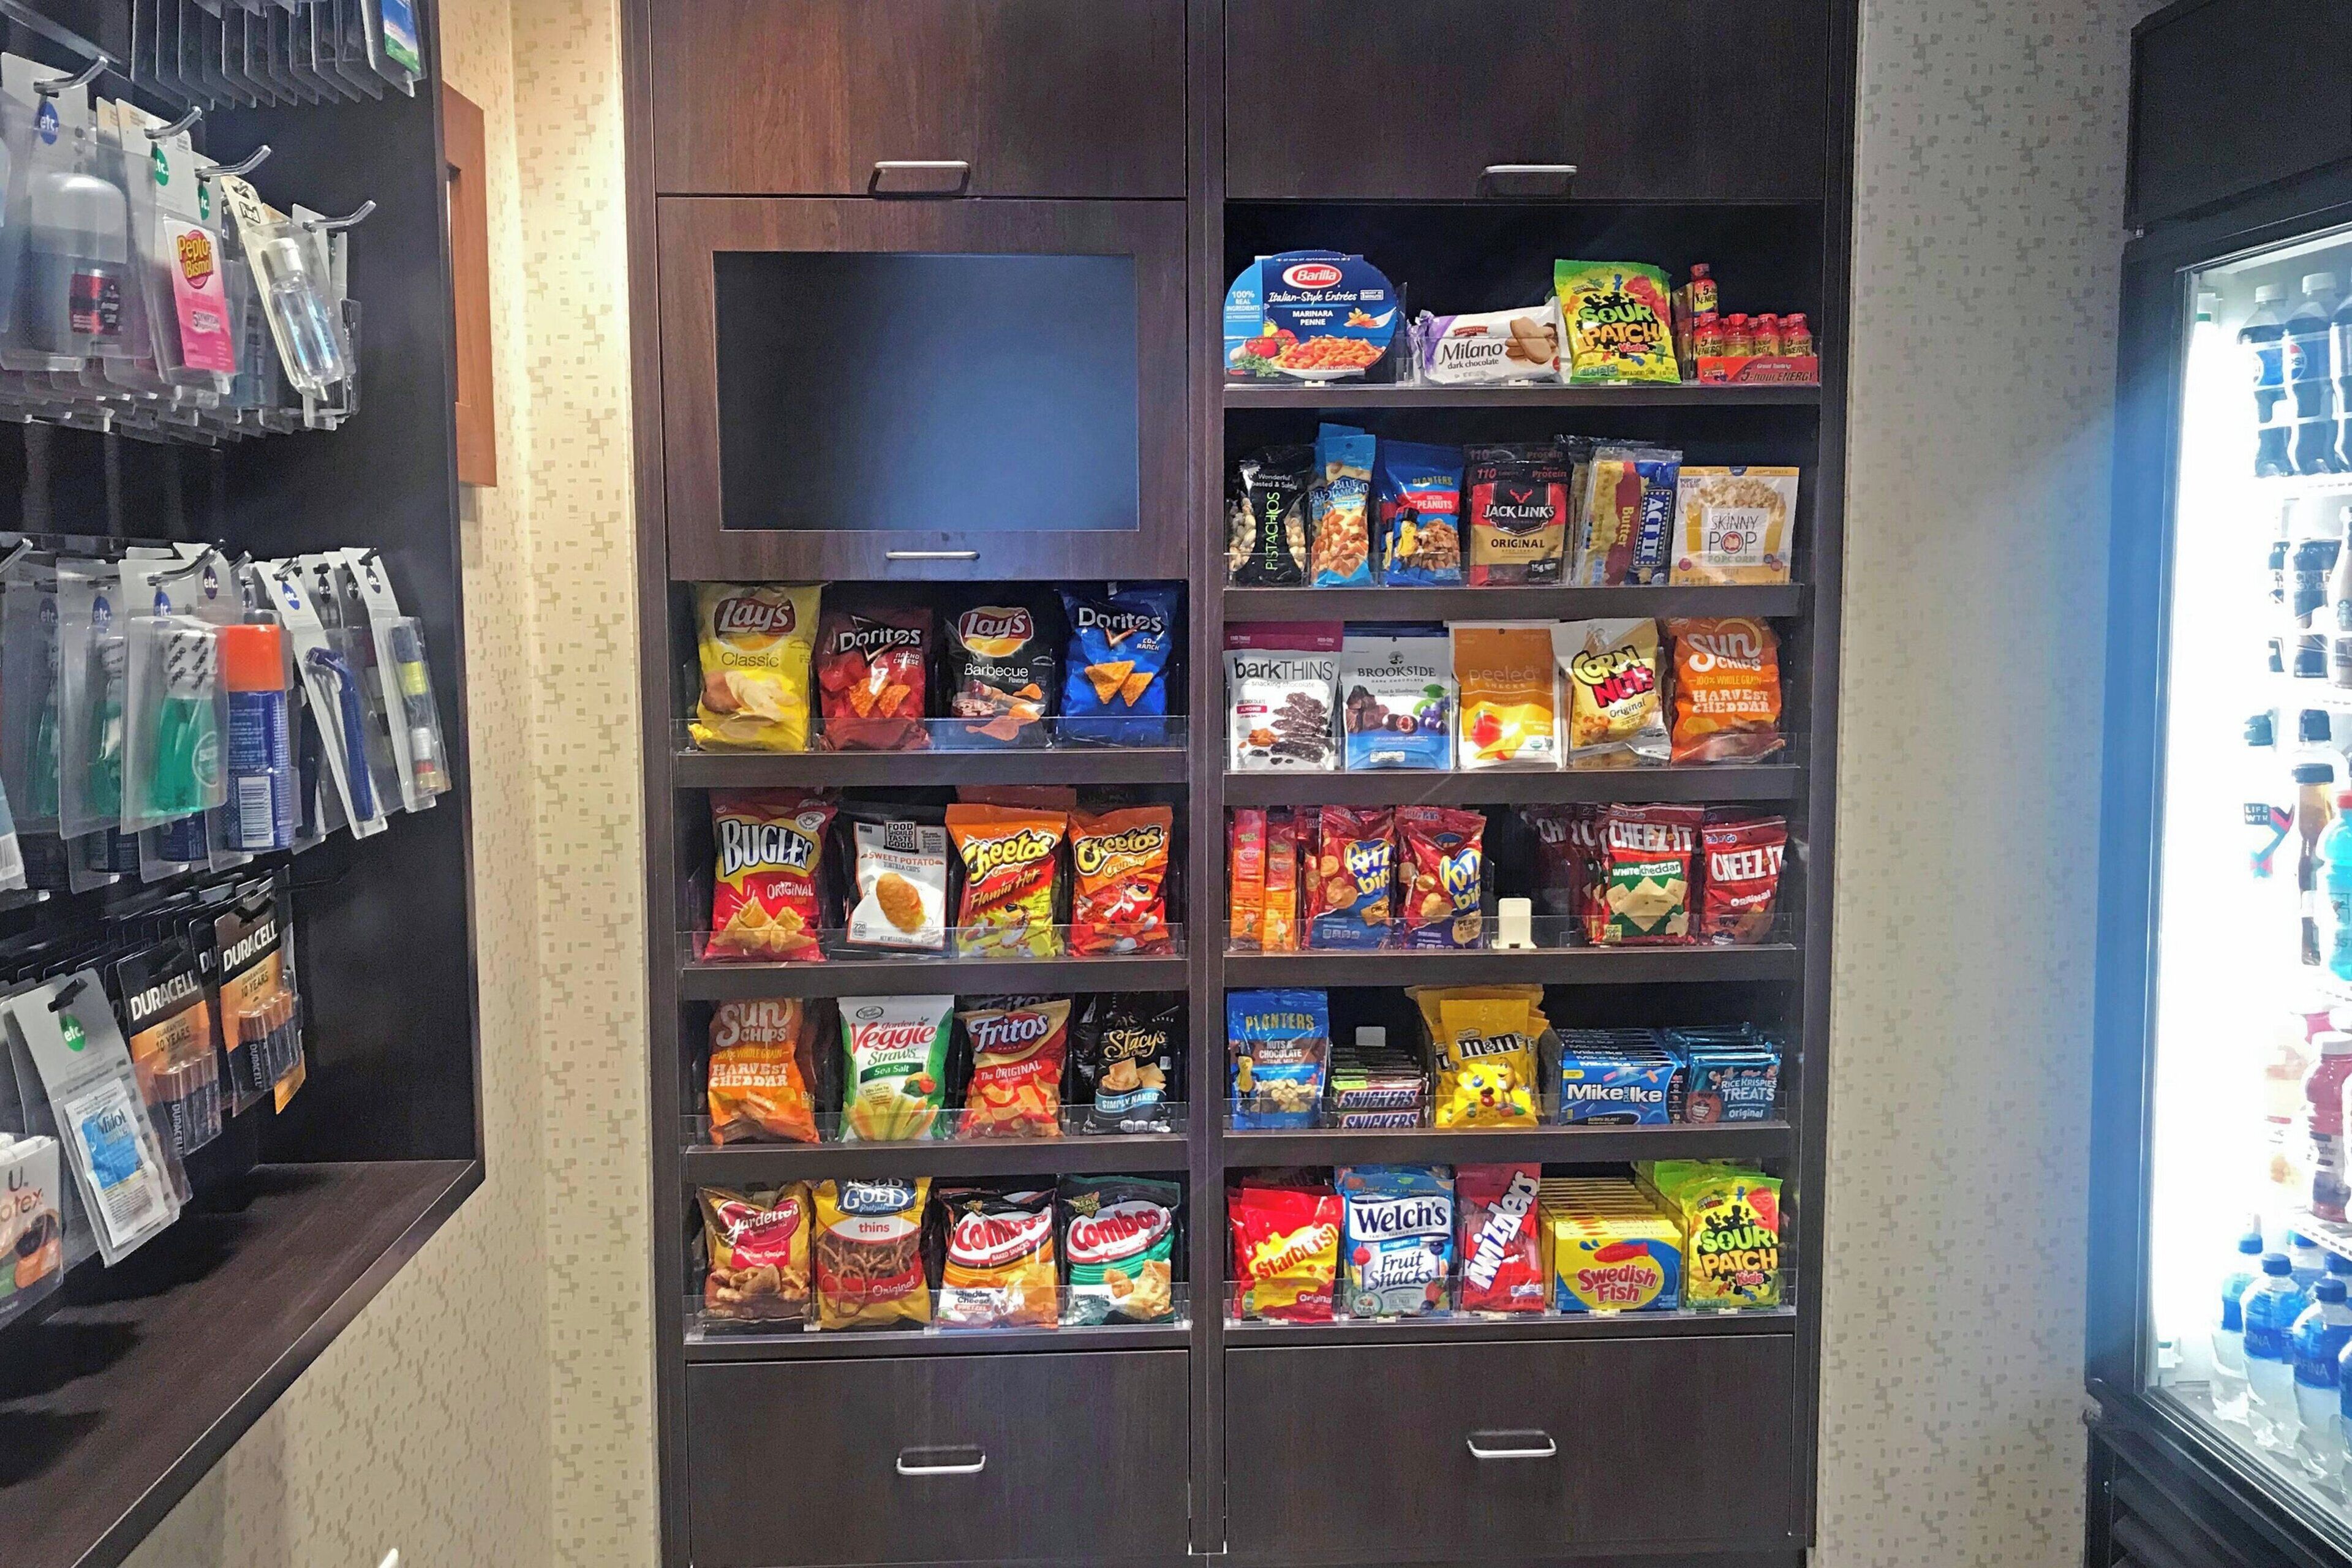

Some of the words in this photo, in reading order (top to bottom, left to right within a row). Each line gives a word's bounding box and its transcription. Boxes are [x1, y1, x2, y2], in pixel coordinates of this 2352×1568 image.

[177, 235, 211, 260] Pepto-
[185, 252, 214, 278] Bismol
[1297, 270, 1336, 281] Barilla
[1268, 290, 1323, 306] Italian-Style
[1325, 290, 1357, 301] Entrées
[1579, 303, 1653, 323] SOUR
[1579, 322, 1662, 347] PATCH
[1439, 339, 1503, 365] Milano
[1465, 358, 1499, 368] chocolate
[1777, 371, 1814, 382] ENERGY
[1417, 500, 1453, 510] PEANUTS
[1482, 505, 1517, 519] JACK
[1517, 505, 1555, 519] LINK'S
[1265, 492, 1281, 571] PISTACHIOS
[1618, 506, 1635, 546] Butter
[1711, 513, 1759, 530] SKINNY
[1491, 538, 1545, 548] ORIGINAL
[1708, 531, 1757, 554] POP
[718, 598, 791, 635] Lay's
[965, 612, 1027, 640] Lay's
[1079, 606, 1164, 632] Doritos
[839, 627, 921, 652] Doritos
[1687, 619, 1763, 672] Sun
[721, 650, 779, 668] Classic
[1234, 657, 1333, 680] barkTHINS
[1716, 656, 1762, 671] CHIPS
[964, 663, 1028, 677] Barbecue
[1357, 666, 1436, 677] BROOKSIDE
[1715, 675, 1739, 685] WHOLE
[1692, 689, 1768, 703] HARVEST
[1609, 698, 1646, 717] Original
[1692, 700, 1771, 714] CHEDDAR
[1608, 820, 1693, 852] CHEEZ-IT
[1725, 834, 1737, 843] Go
[720, 820, 814, 877] BUGLES
[868, 851, 898, 862] SWEET
[900, 857, 935, 866] POTATO
[962, 830, 1056, 883] Cheetos
[1076, 825, 1163, 875] Cheetos
[1017, 869, 1041, 888] Hot
[1611, 867, 1640, 876] WHITE
[1640, 861, 1681, 876] cheddar
[767, 881, 815, 899] ORIGINAL
[223, 919, 278, 973] DURACELL
[249, 971, 270, 994] YEARS
[130, 970, 198, 1022] DURACELL
[715, 997, 792, 1047] Sun
[881, 1020, 915, 1030] Garden
[1246, 1012, 1314, 1033] PLANTERS
[63, 1027, 85, 1042] etc.
[156, 1039, 165, 1054] 10
[167, 1026, 191, 1048] YEARS
[741, 1027, 786, 1042] CHIPS
[850, 1021, 937, 1055] Veggie
[968, 1014, 1049, 1054] Fritos
[1104, 1028, 1166, 1059] Stacy's
[735, 1049, 760, 1058] WHOLE
[1259, 1049, 1302, 1059] CHOCOLATE
[1266, 1041, 1286, 1049] NUTS
[249, 1042, 263, 1087] DURACELL
[867, 1047, 917, 1066] Straws
[712, 1062, 788, 1076] HARVEST
[981, 1071, 993, 1081] The
[995, 1060, 1042, 1077] ORIGINAL
[709, 1074, 788, 1087] CHEDDAR
[1721, 1080, 1741, 1089] RICE
[1741, 1078, 1777, 1088] KRISPIES
[1102, 1096, 1131, 1110] SIMPLY
[1131, 1092, 1159, 1103] NAKED
[1341, 1090, 1417, 1107] SNICKERS
[1567, 1084, 1624, 1101] Mike
[1630, 1086, 1663, 1103] Ike
[1722, 1087, 1775, 1102] TREATS
[1345, 1113, 1418, 1129] SNICKERS
[1728, 1108, 1764, 1119] Original
[9, 1169, 29, 1193] U.
[843, 1185, 909, 1210] GOLD
[859, 1221, 890, 1233] thins
[1354, 1202, 1447, 1234] Welch's
[1071, 1208, 1161, 1251] Combos
[1700, 1225, 1771, 1253] SOUR
[1381, 1251, 1425, 1274] Fruit
[1700, 1248, 1778, 1278] PATCH
[872, 1274, 916, 1297] Original
[1367, 1266, 1433, 1291] Snacks
[1577, 1264, 1657, 1292] Swedish
[1735, 1270, 1764, 1286] Kids
[1595, 1283, 1641, 1303] Fish
